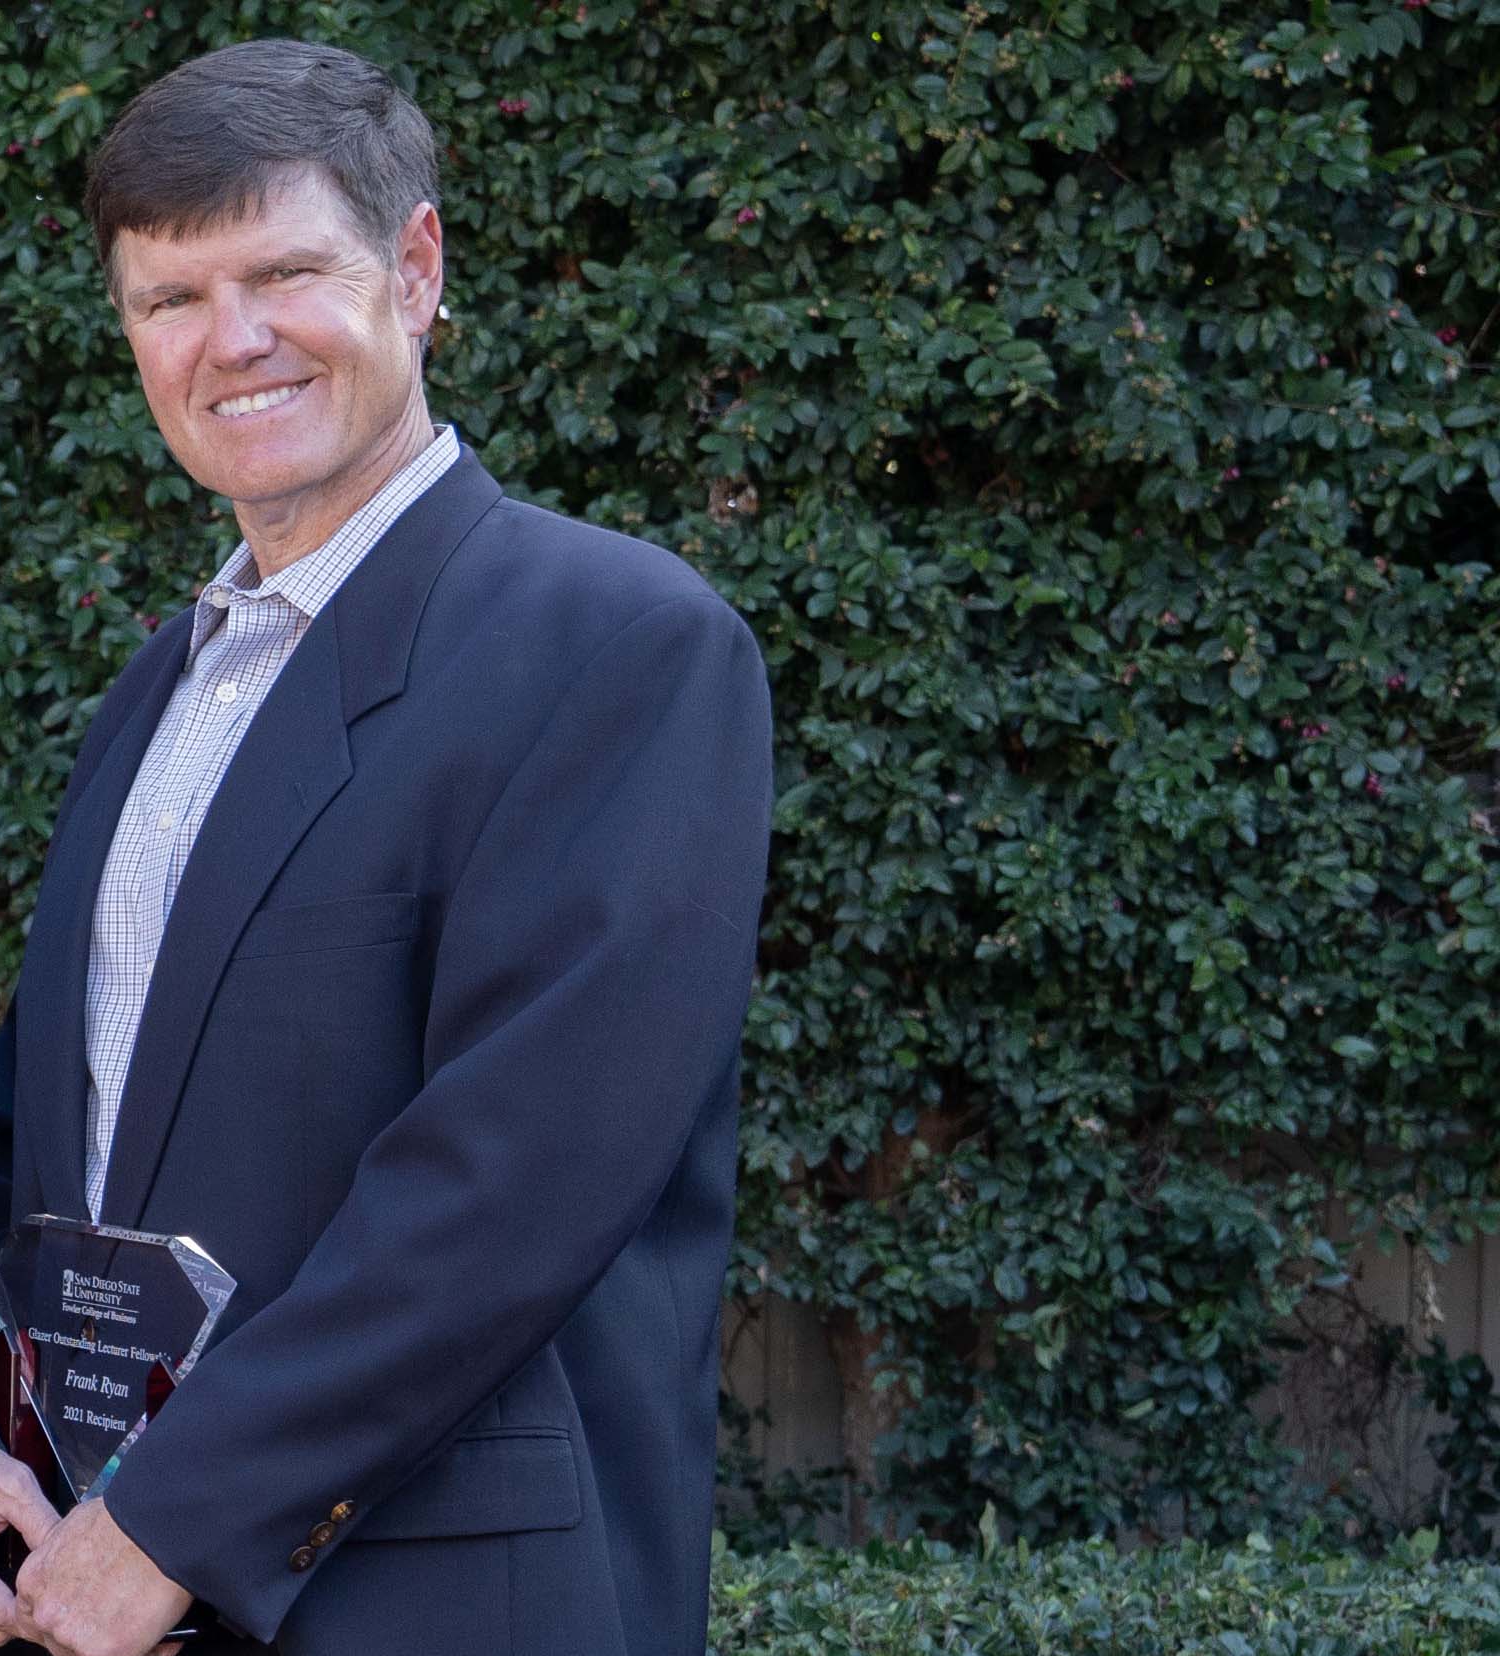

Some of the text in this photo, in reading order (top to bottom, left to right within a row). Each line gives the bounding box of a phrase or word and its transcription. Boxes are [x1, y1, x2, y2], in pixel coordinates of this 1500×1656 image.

[74, 1272, 141, 1296] SAN DIEGO STATE
[74, 1286, 122, 1306] UNIVERSITY
[28, 1327, 52, 1343] Glazer
[53, 1331, 97, 1354] Outstanding
[97, 1340, 129, 1359] Lecturer
[64, 1369, 129, 1399] Frank Ryan
[63, 1405, 127, 1432] 2021 Recipient
